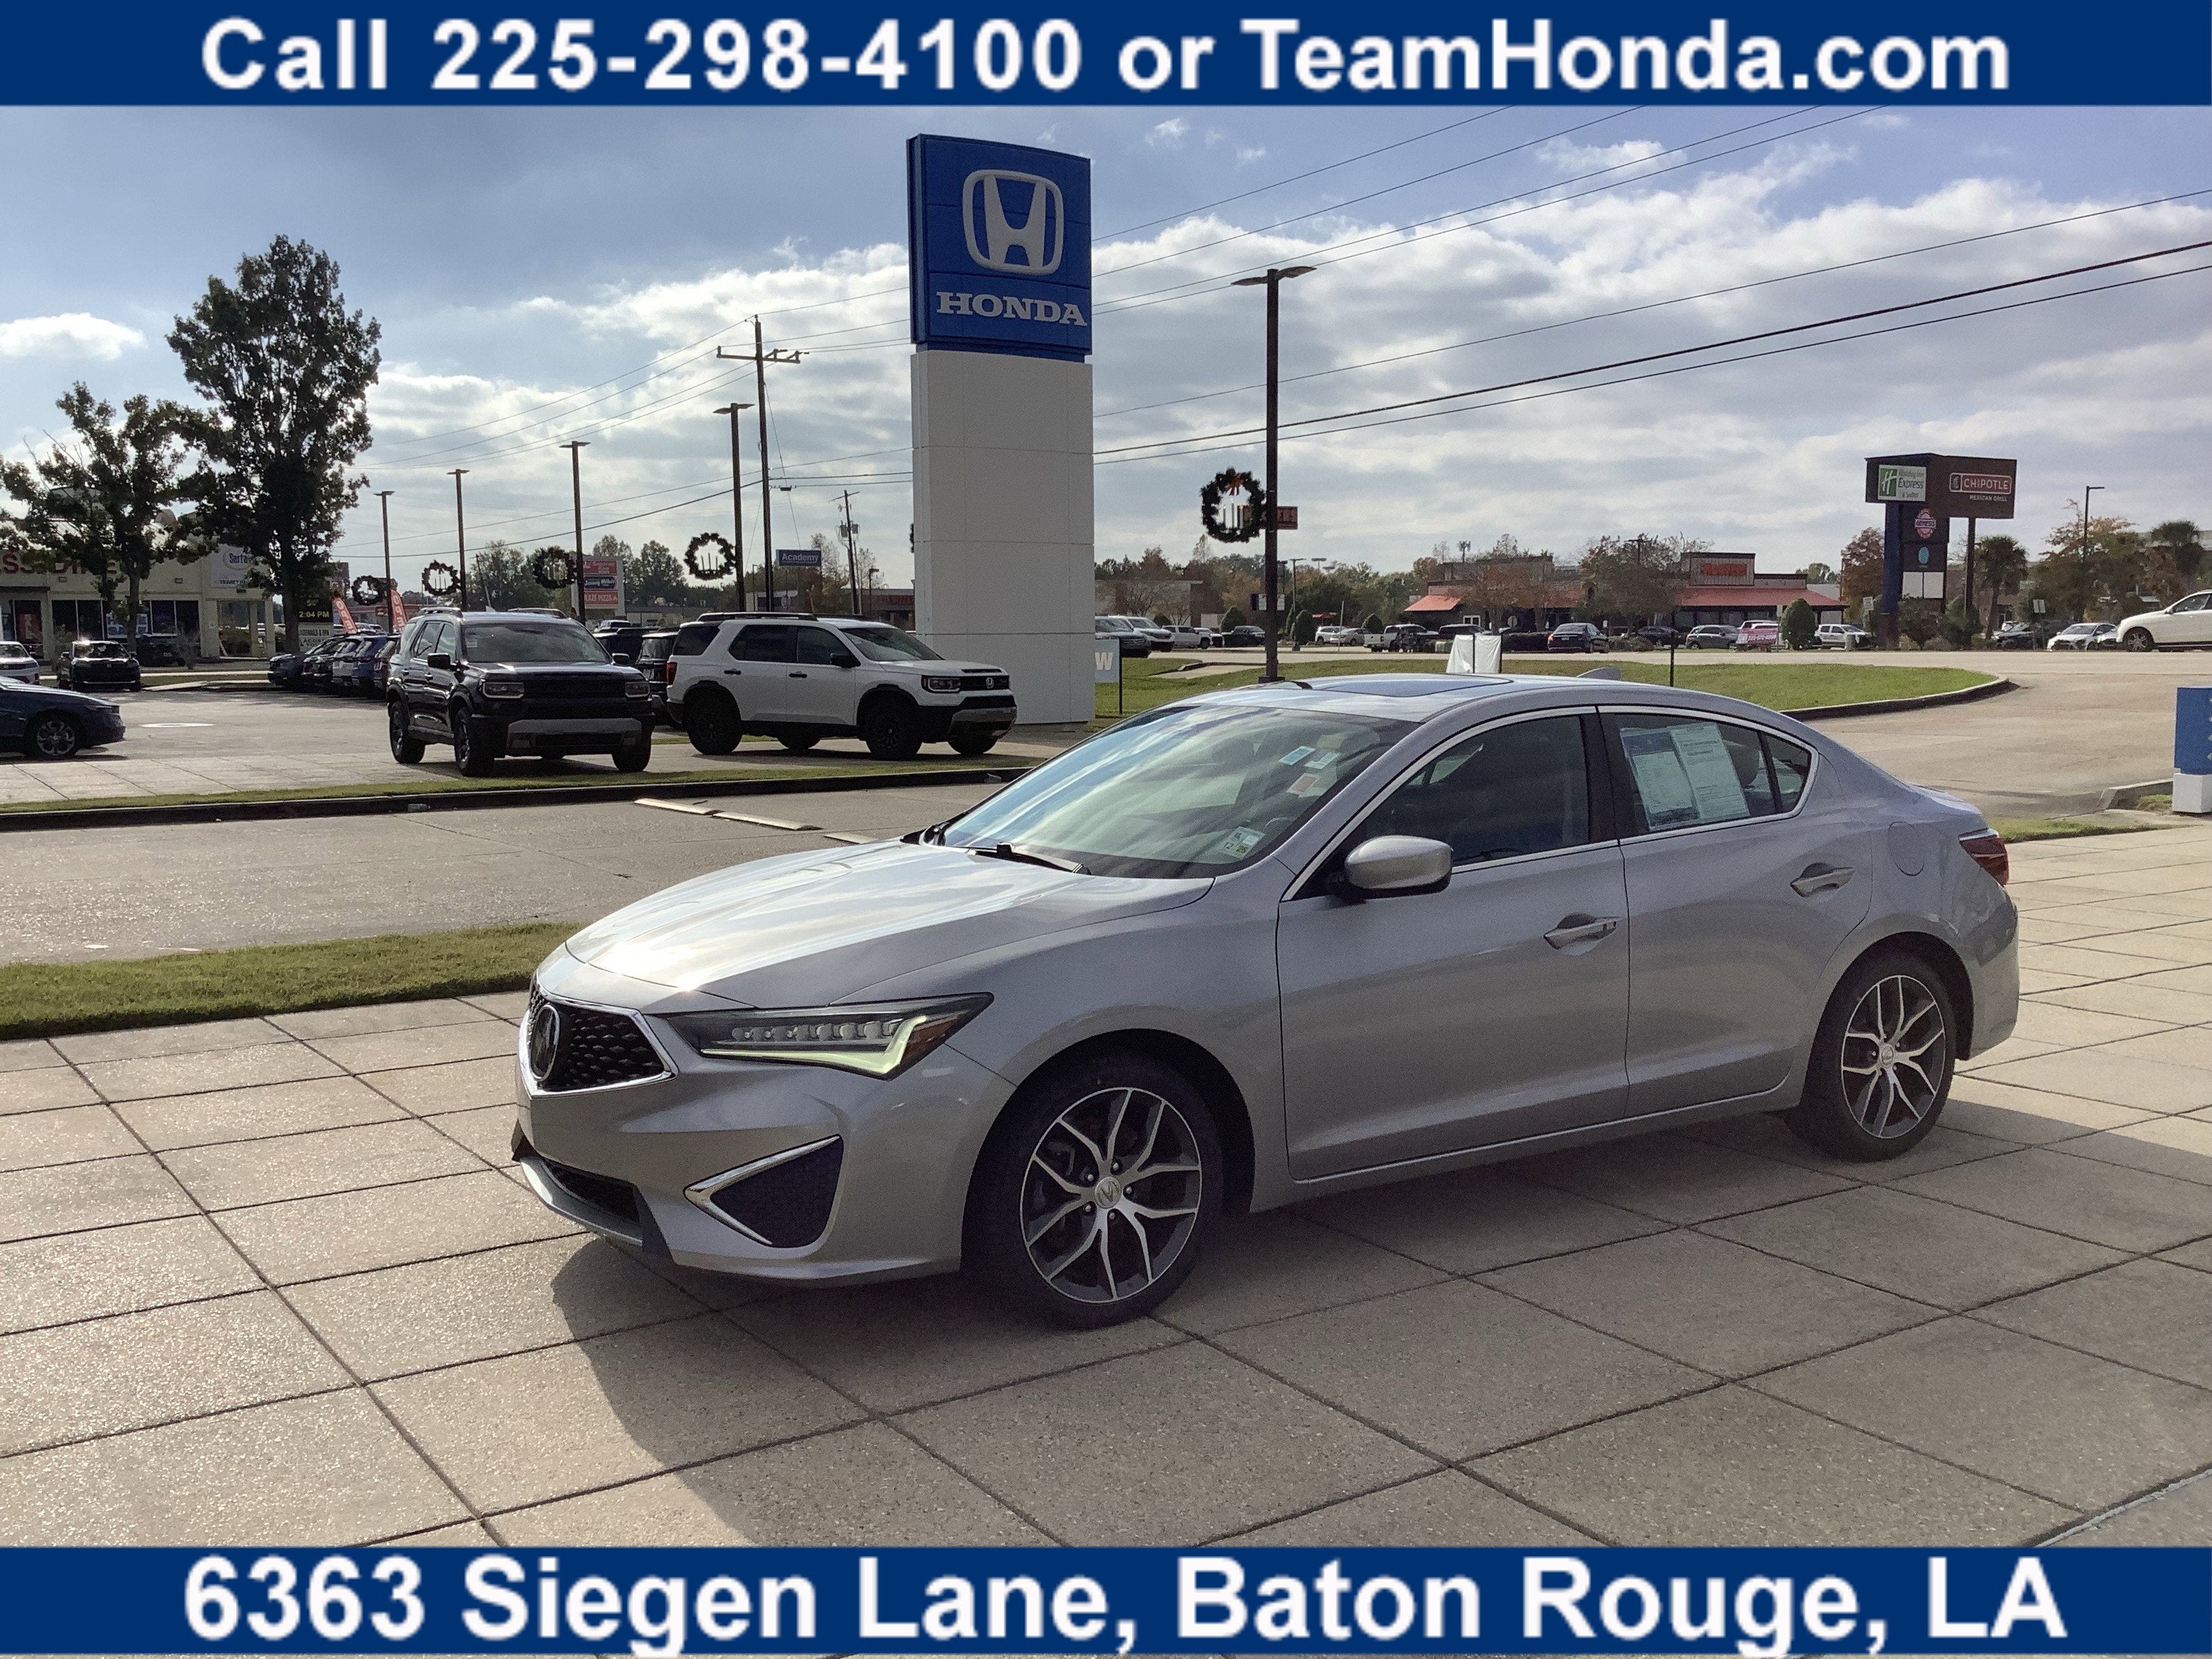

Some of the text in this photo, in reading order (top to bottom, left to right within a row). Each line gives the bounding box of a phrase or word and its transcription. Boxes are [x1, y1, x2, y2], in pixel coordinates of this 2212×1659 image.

[936, 291, 1088, 327] HONDA
[1964, 478, 2009, 489] CHIPOTLE
[781, 553, 819, 563] Academy
